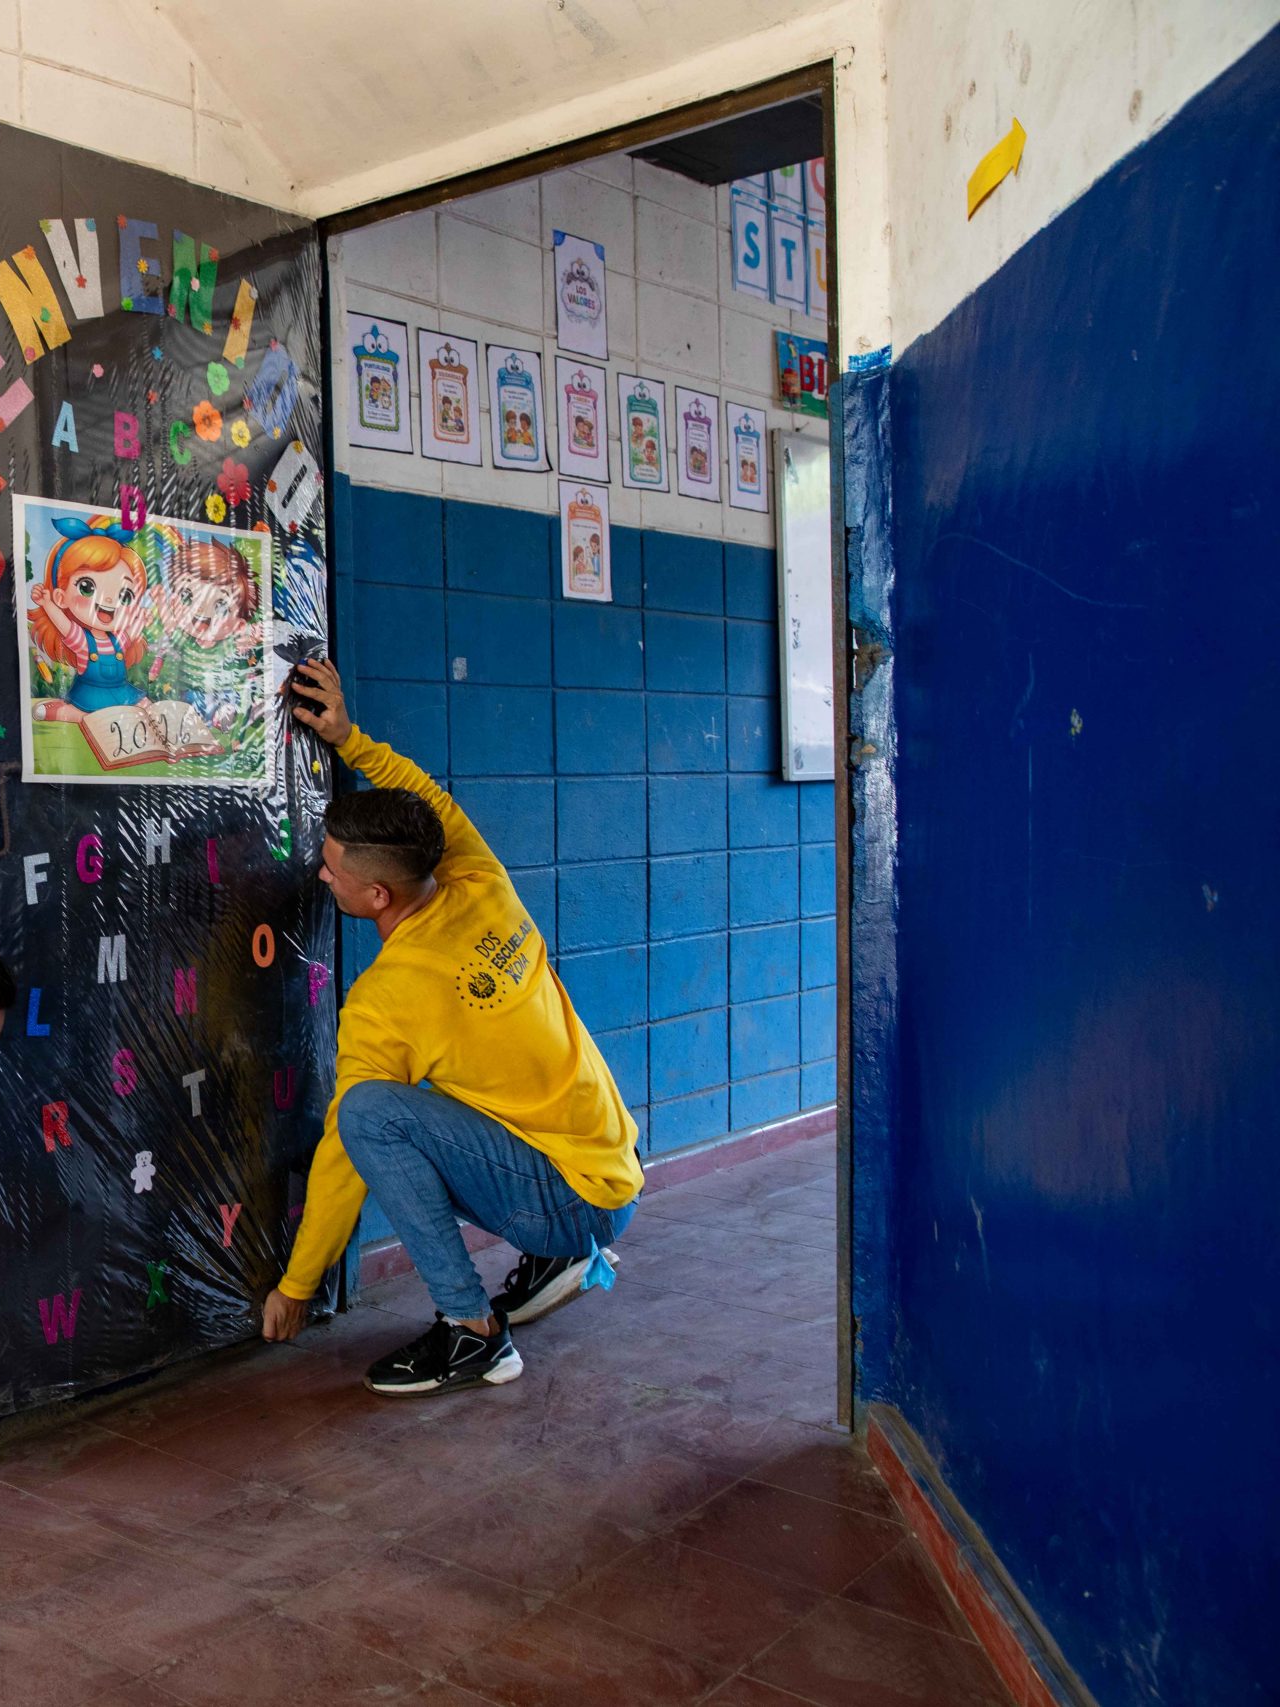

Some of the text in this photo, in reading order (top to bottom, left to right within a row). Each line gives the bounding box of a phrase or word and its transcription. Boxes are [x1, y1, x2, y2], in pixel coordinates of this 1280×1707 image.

[743, 221, 760, 269] S
[781, 237, 796, 281] T
[567, 293, 595, 310] VALORES
[576, 285, 587, 295] LOS
[799, 354, 826, 396] BI
[51, 401, 192, 465] A B C
[120, 484, 146, 531] D
[110, 713, 191, 757] 2026
[24, 853, 50, 904] F
[75, 834, 103, 884] G
[145, 817, 170, 866] H
[271, 814, 292, 862] J
[475, 931, 501, 958] DOS
[26, 923, 328, 1036] L M N O P
[42, 1101, 72, 1153] R
[112, 1048, 138, 1097] S
[182, 1069, 206, 1117] T
[274, 1066, 295, 1111] U
[39, 1289, 83, 1345] W
[146, 1259, 168, 1309] X
[220, 1203, 241, 1247] Y
